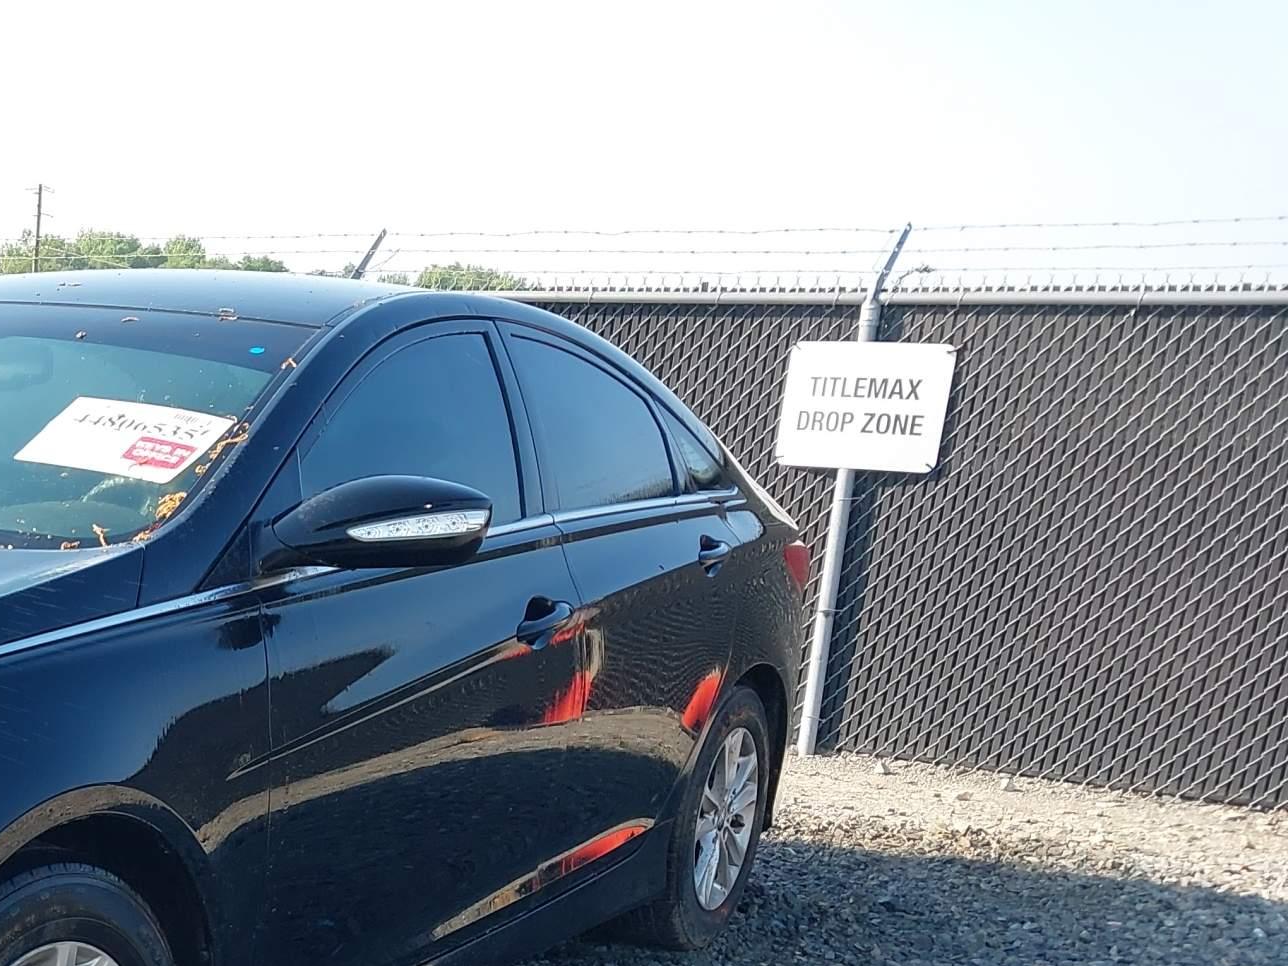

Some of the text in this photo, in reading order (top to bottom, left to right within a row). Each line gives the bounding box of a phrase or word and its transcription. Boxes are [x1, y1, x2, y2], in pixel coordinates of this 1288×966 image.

[810, 376, 924, 401] TITLEMAX
[796, 410, 925, 436] DROP ZONE
